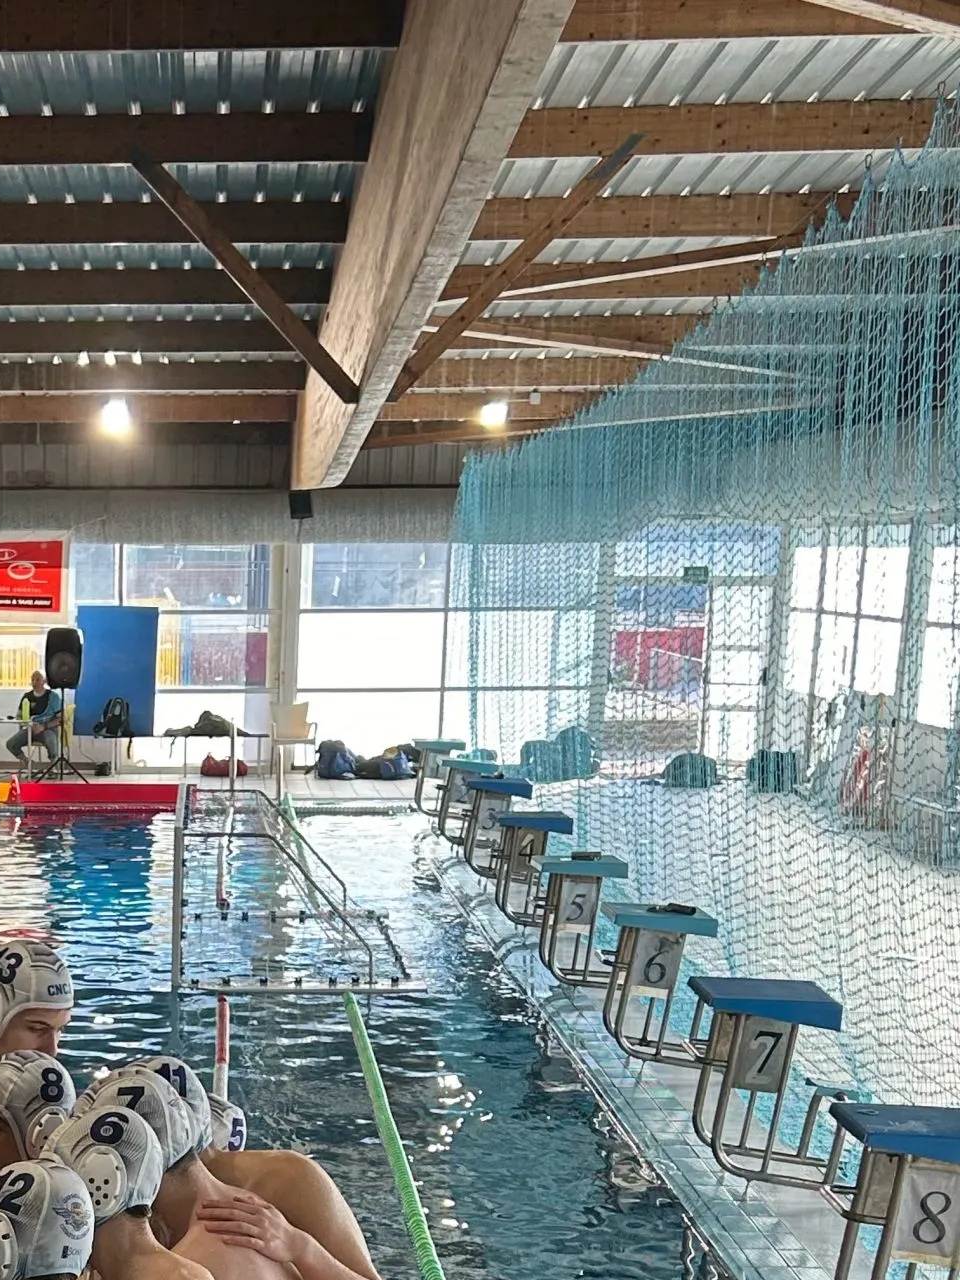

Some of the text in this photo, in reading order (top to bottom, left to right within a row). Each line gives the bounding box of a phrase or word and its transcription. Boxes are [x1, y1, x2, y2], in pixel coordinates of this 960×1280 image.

[482, 807, 499, 830] 3
[519, 839, 537, 864] 4
[566, 893, 587, 921] 5
[644, 950, 669, 984] 6
[752, 1030, 783, 1075] 7
[40, 1067, 64, 1103] 8
[155, 1063, 187, 1098] 11
[117, 1086, 145, 1111] 7
[90, 1111, 130, 1145] 6
[228, 1117, 245, 1151] 5
[912, 1191, 952, 1244] 8
